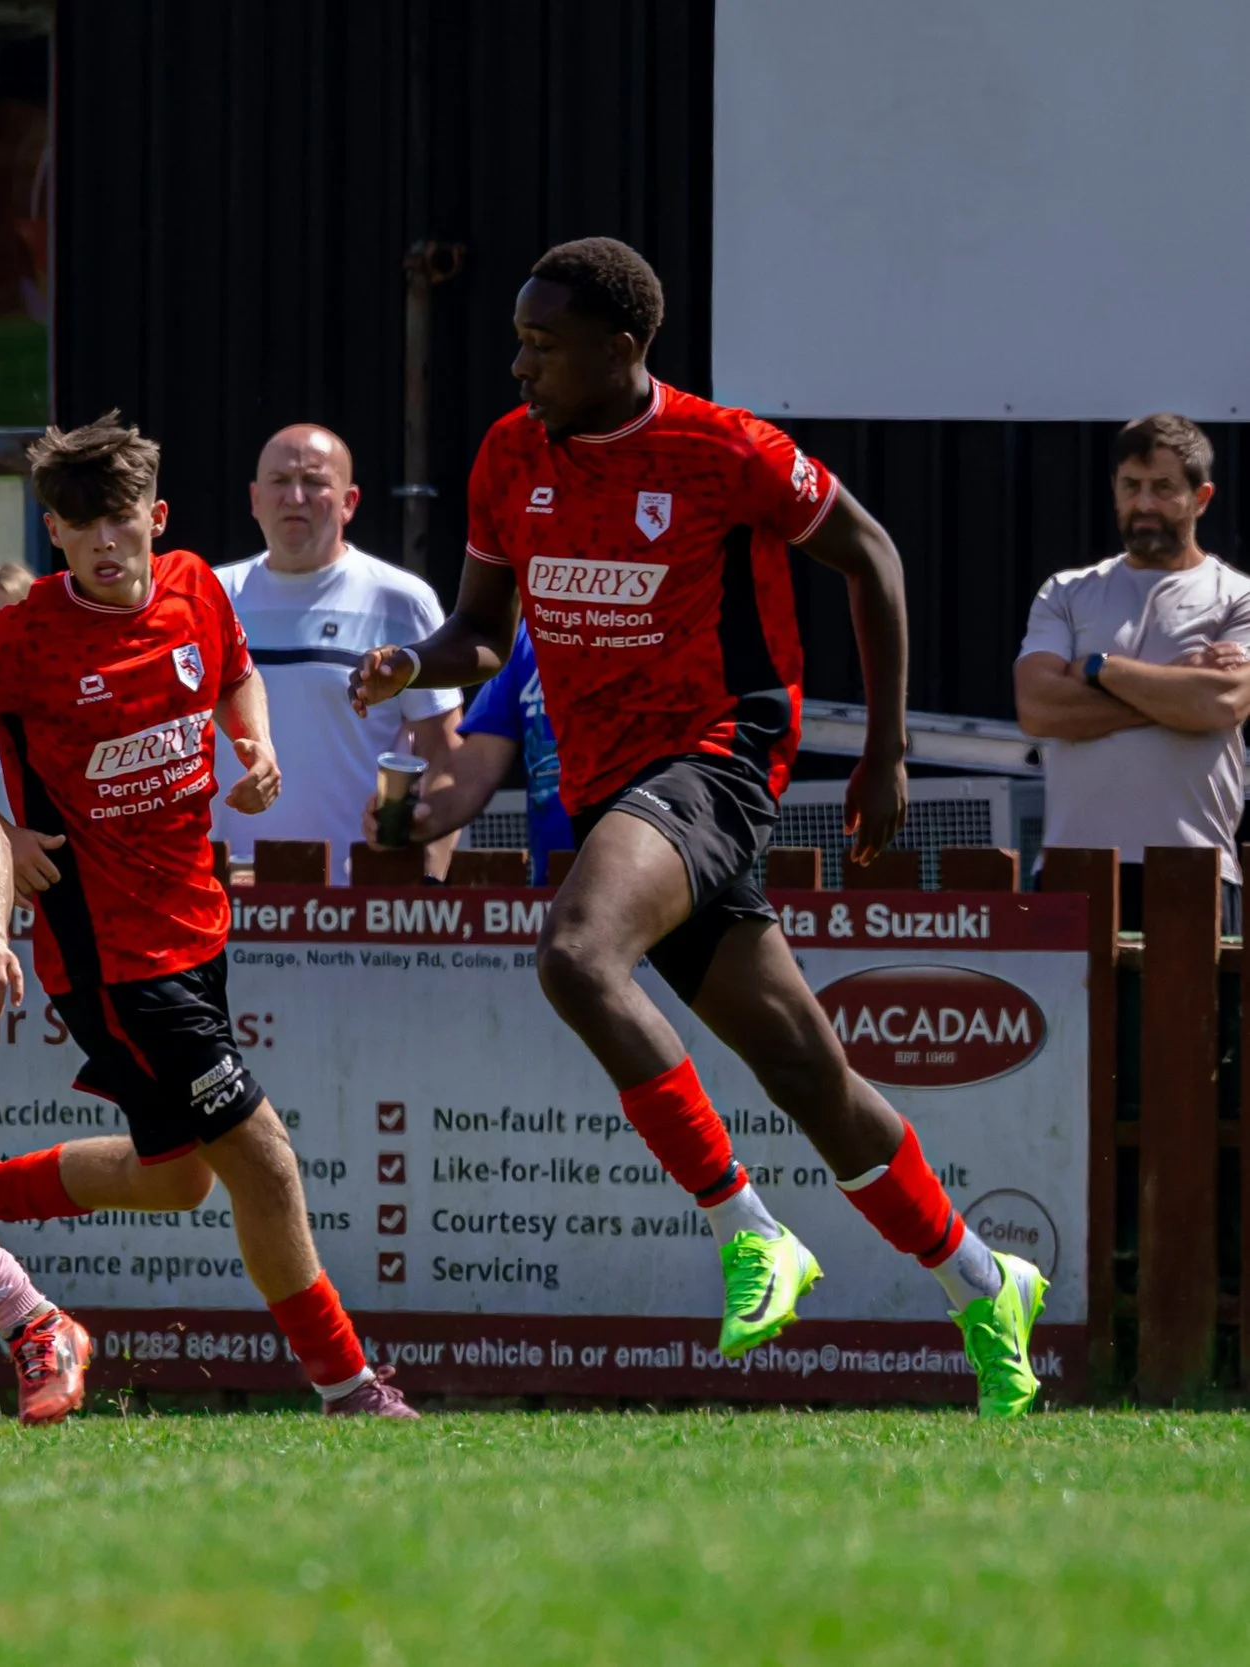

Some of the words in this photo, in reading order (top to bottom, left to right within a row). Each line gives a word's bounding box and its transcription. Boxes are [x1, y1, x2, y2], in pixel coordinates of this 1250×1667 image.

[532, 562, 655, 598] PERRYS
[534, 603, 582, 628] Perrys
[586, 610, 653, 628] Nelson
[94, 718, 207, 773] PERRYS
[97, 774, 161, 800] Perrys
[163, 755, 203, 786] Nelson
[90, 796, 165, 819] OMODA
[304, 899, 355, 931] for
[365, 900, 473, 938] BMW,
[484, 900, 552, 934] BM
[828, 903, 854, 938] &
[865, 903, 990, 939] Suzuki
[233, 949, 300, 968] Garage,
[306, 949, 354, 967] North
[358, 950, 411, 970] Valley
[416, 951, 446, 970] Rd,
[451, 952, 508, 972] Colne,
[432, 1106, 567, 1134] Non-fault
[433, 1157, 600, 1185] Like-for-like
[793, 1165, 827, 1187] on
[431, 1208, 557, 1243] Courtesy
[565, 1213, 622, 1237] cars
[130, 1255, 245, 1283] approve
[432, 1255, 559, 1289] Servicing
[105, 1332, 180, 1359] 01282
[186, 1333, 276, 1362] 864219
[388, 1341, 443, 1368] your
[452, 1337, 544, 1367] vehicle
[551, 1339, 573, 1367] in
[581, 1345, 607, 1369] or
[614, 1341, 684, 1369] email
